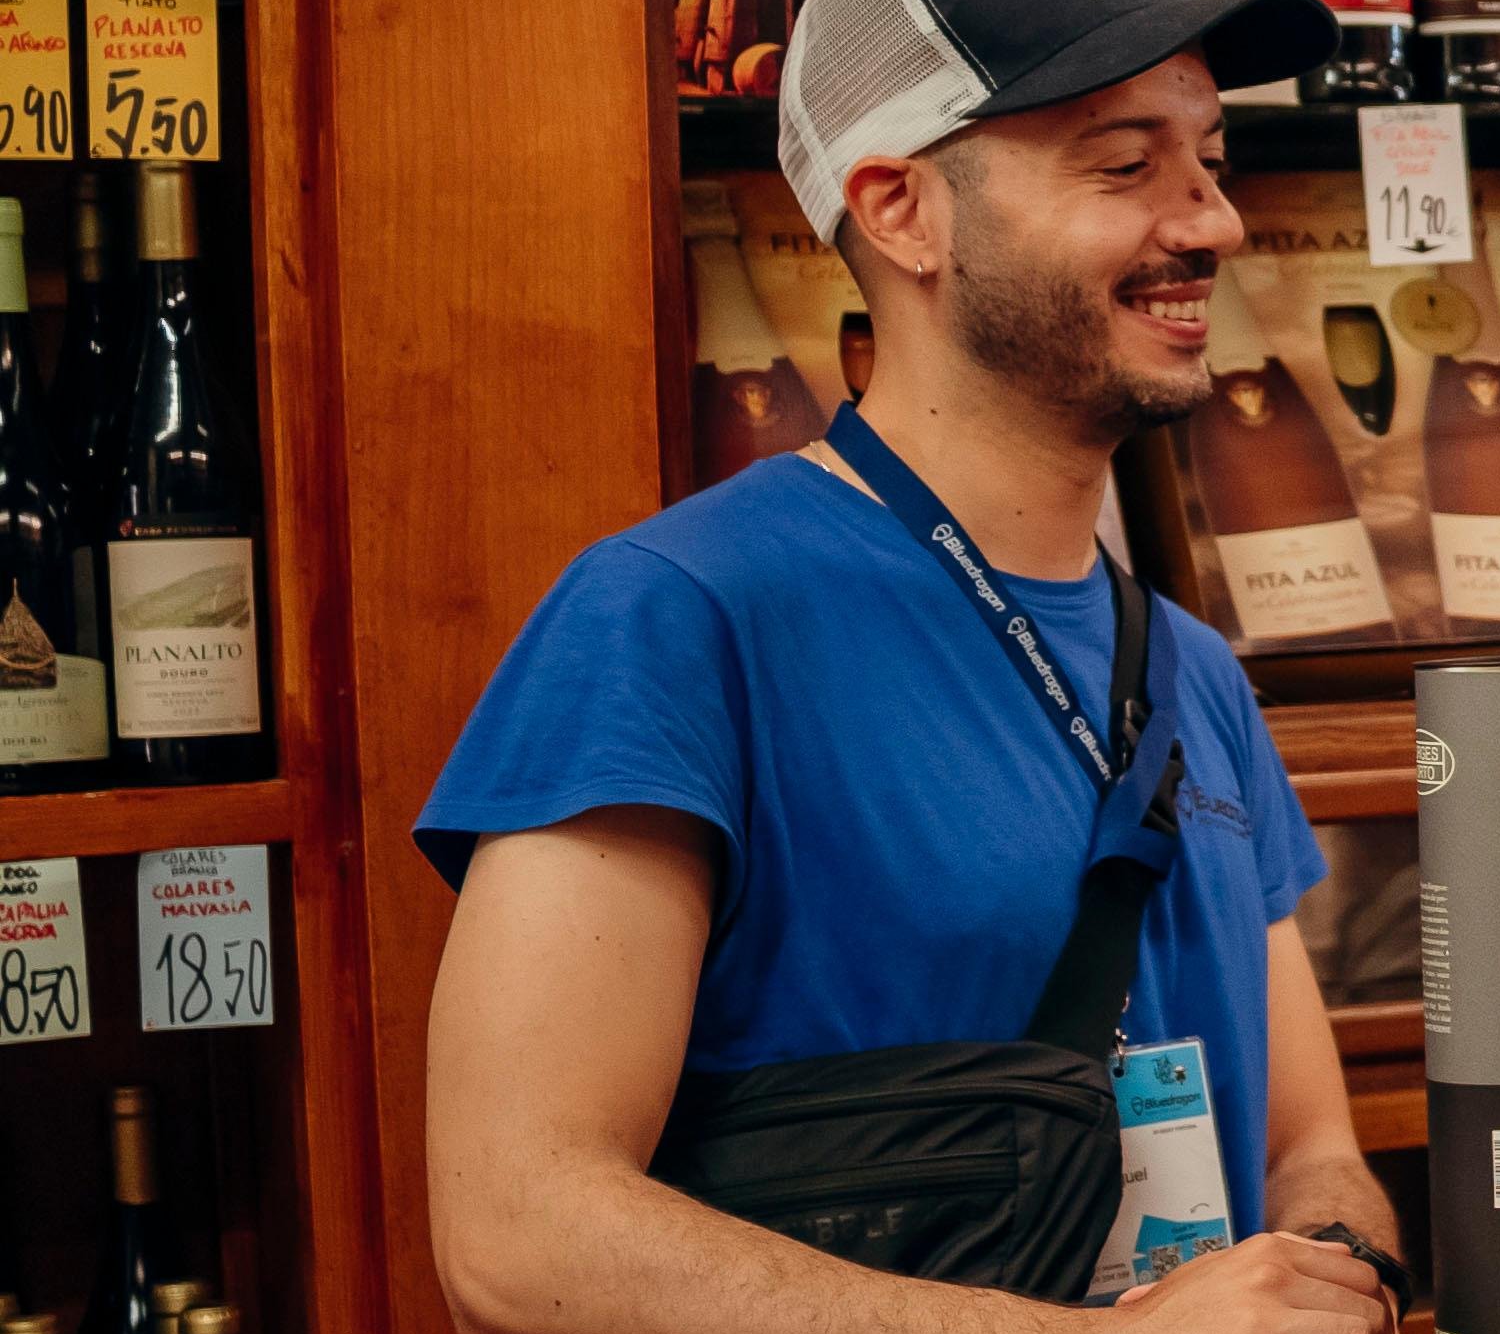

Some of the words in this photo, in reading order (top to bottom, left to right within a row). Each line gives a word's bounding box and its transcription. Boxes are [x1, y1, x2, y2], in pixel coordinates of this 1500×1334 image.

[94, 15, 204, 40] PLANALTO
[103, 40, 187, 60] RESERVA
[105, 69, 208, 159] 5.50
[941, 533, 1007, 614] Bluedragon
[1246, 570, 1296, 592] FITA
[1302, 562, 1361, 586] AZUL
[124, 642, 244, 666] PLANALTO
[1016, 631, 1071, 712] Bluedragon
[151, 878, 236, 901] COLARES
[1143, 1091, 1201, 1111] Bluedragon
